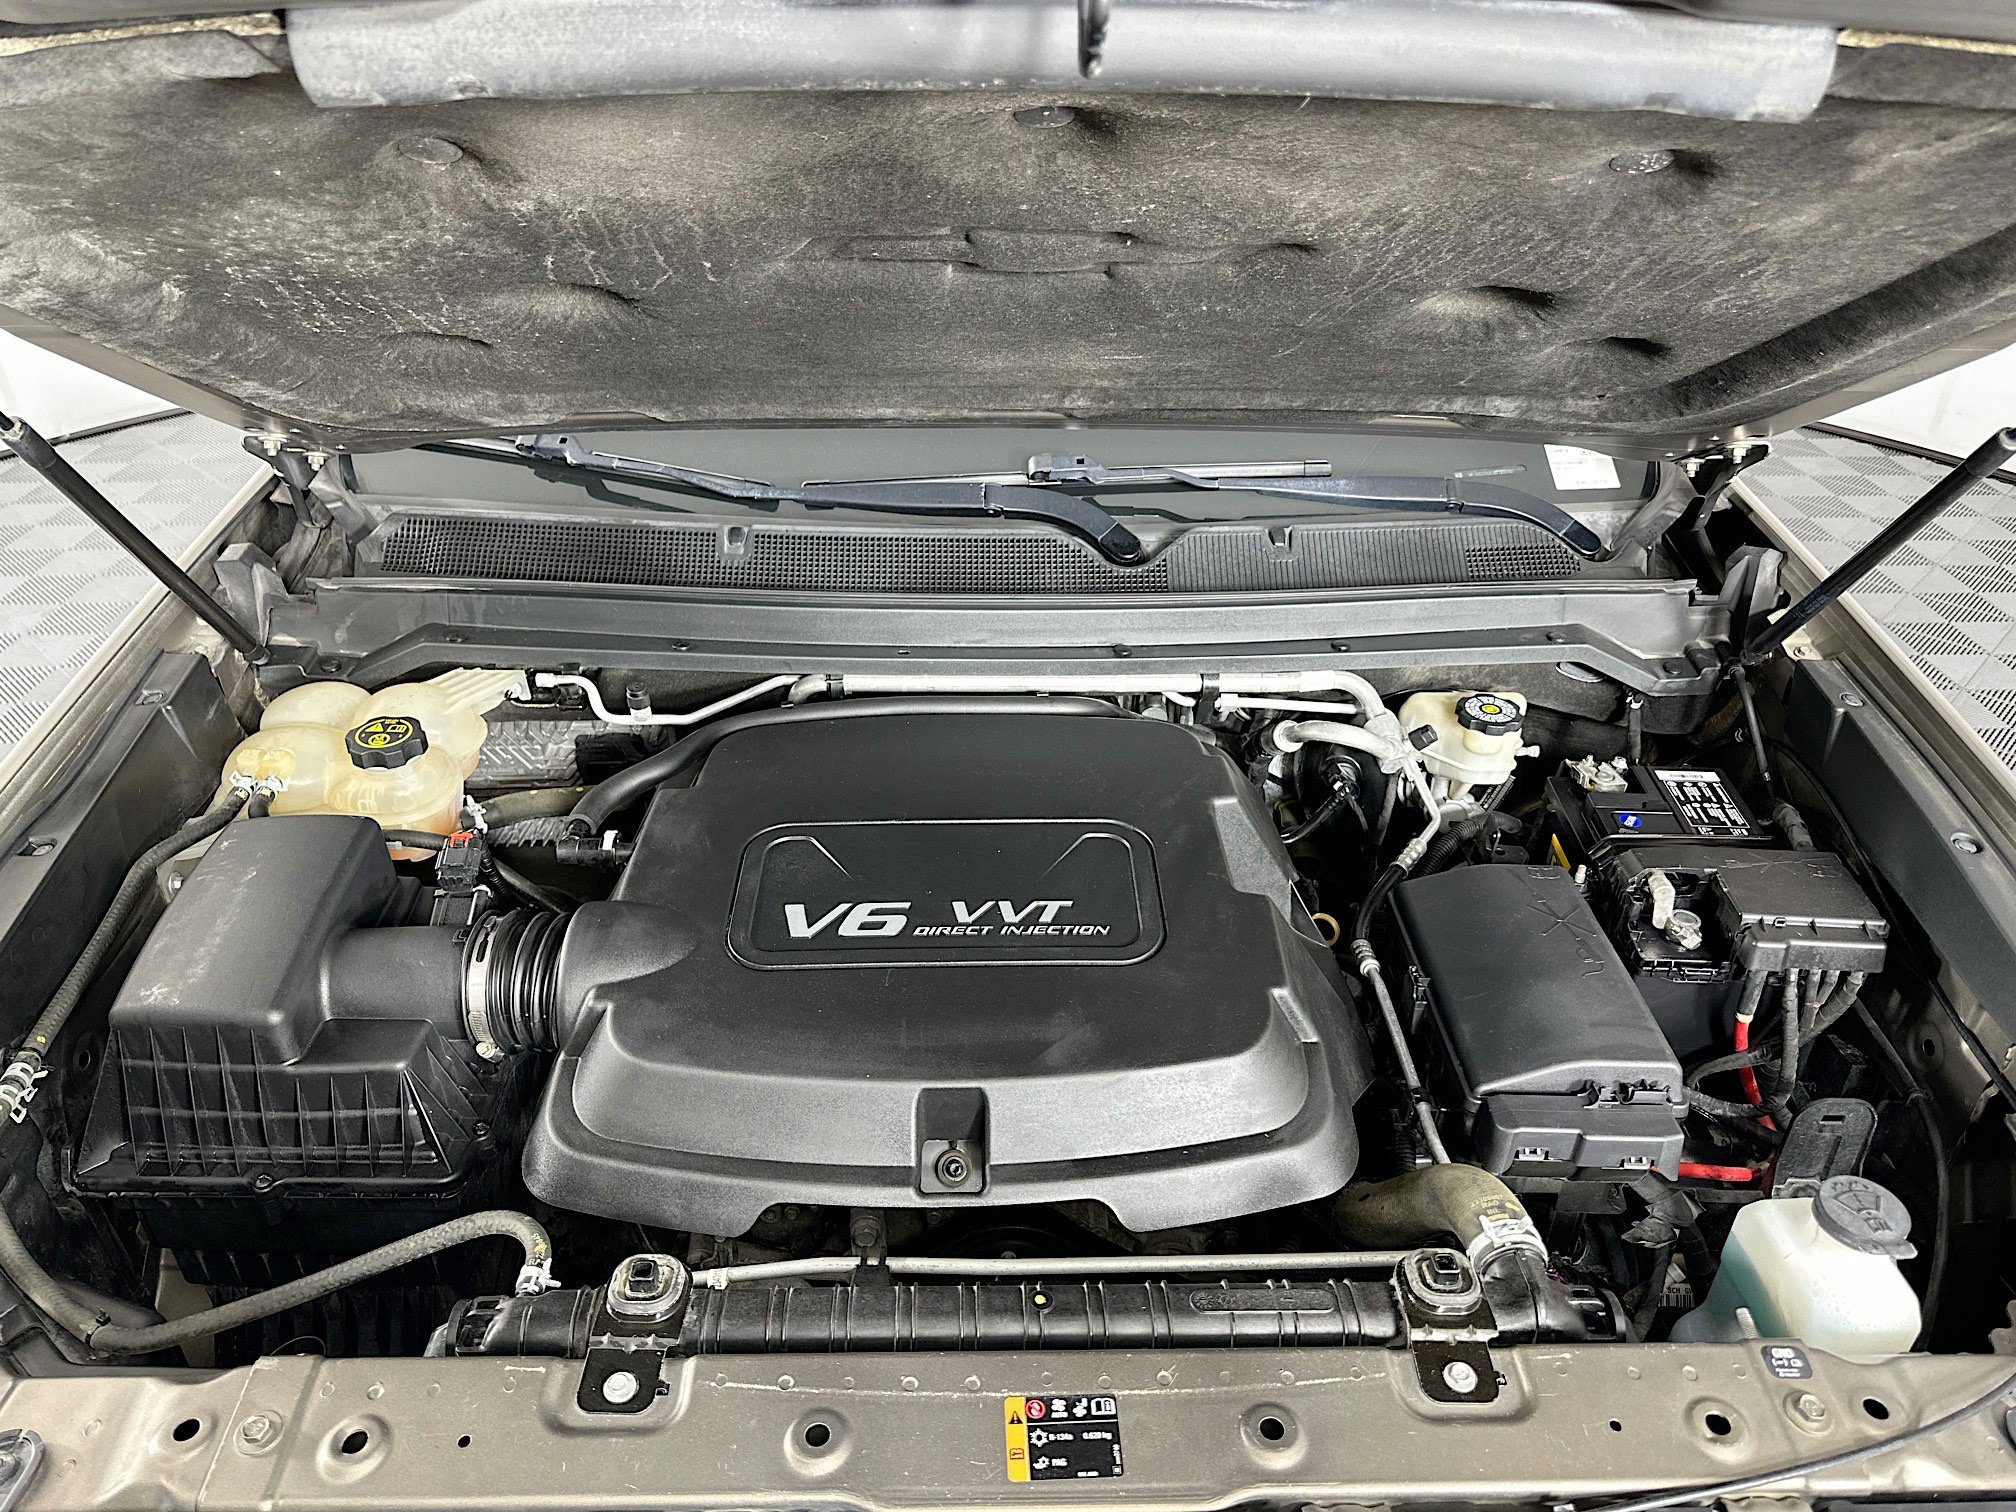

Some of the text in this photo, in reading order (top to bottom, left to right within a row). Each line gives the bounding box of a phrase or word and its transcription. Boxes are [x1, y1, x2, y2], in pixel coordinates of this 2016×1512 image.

[784, 901, 911, 939] V6
[952, 901, 1073, 924] VVT
[913, 924, 1111, 937] DIRECT INJECTION
